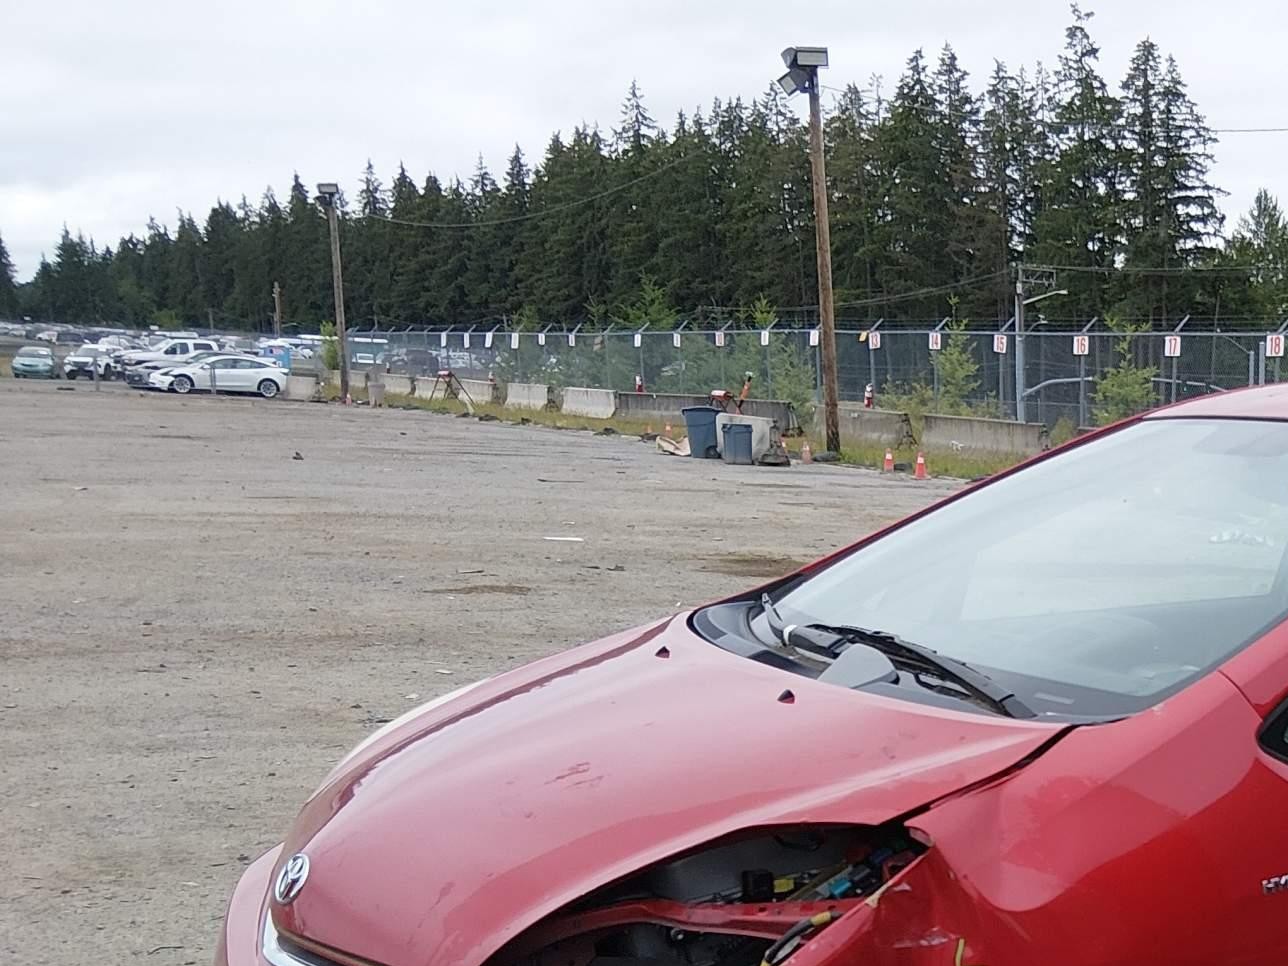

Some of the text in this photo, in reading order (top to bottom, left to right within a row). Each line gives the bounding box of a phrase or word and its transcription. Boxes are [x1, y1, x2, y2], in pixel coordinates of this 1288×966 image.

[931, 332, 939, 348] 14
[996, 336, 1005, 352] 15
[1076, 337, 1086, 354] 16
[1168, 337, 1178, 354] 17
[1269, 336, 1281, 355] 18
